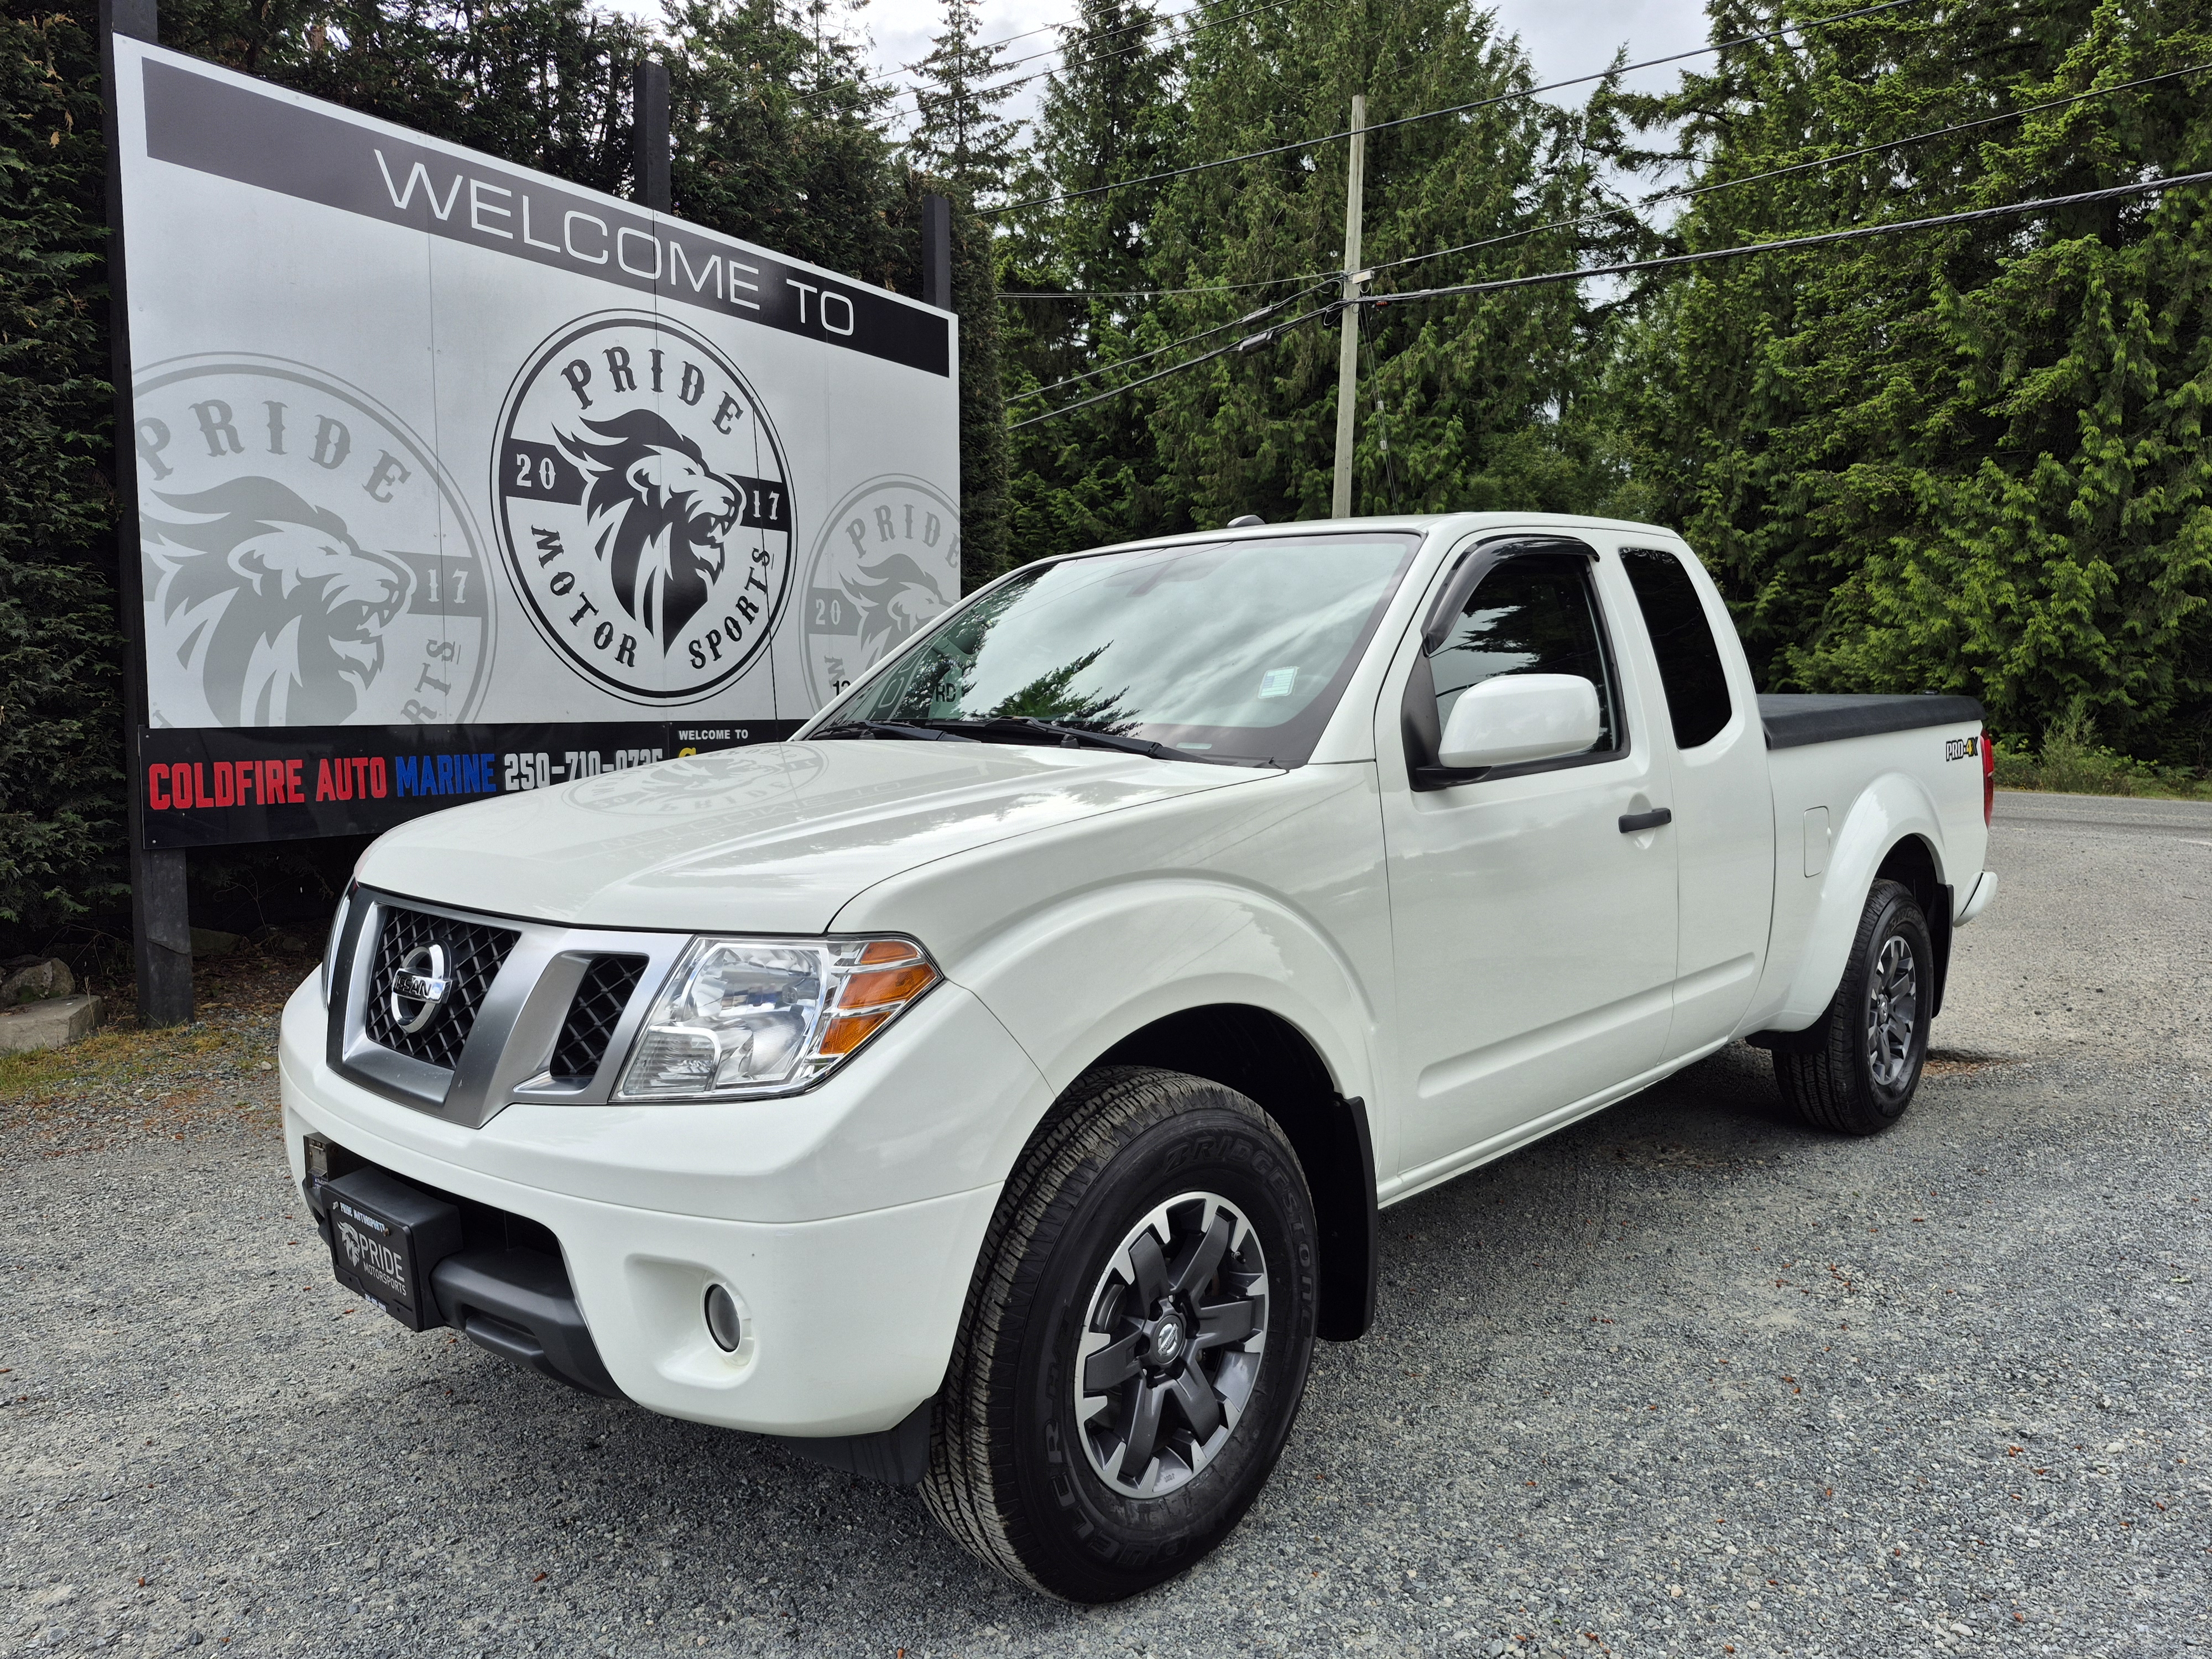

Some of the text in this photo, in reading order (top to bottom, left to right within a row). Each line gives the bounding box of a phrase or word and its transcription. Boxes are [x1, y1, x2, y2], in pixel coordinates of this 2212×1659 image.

[374, 148, 854, 336] WELCOME TO
[560, 346, 744, 435] PRIDE
[134, 399, 411, 503] PRIDE
[515, 453, 556, 489] 20
[752, 490, 779, 520] 17
[846, 504, 959, 568] PRIDE
[427, 568, 468, 604] 17
[531, 524, 639, 667] MOTOR
[688, 547, 773, 670] SPORTS
[816, 598, 841, 625] 20
[679, 729, 749, 740] WELCOME TO
[149, 759, 305, 810] COLDFIRE
[316, 757, 387, 802] AUTO
[395, 753, 497, 797] MARINE
[394, 975, 432, 997] ISSAN
[359, 1233, 405, 1282] PRIDE
[1162, 1135, 1313, 1339] BRIDGESTONE
[363, 1261, 406, 1296] MOTORSPORTS
